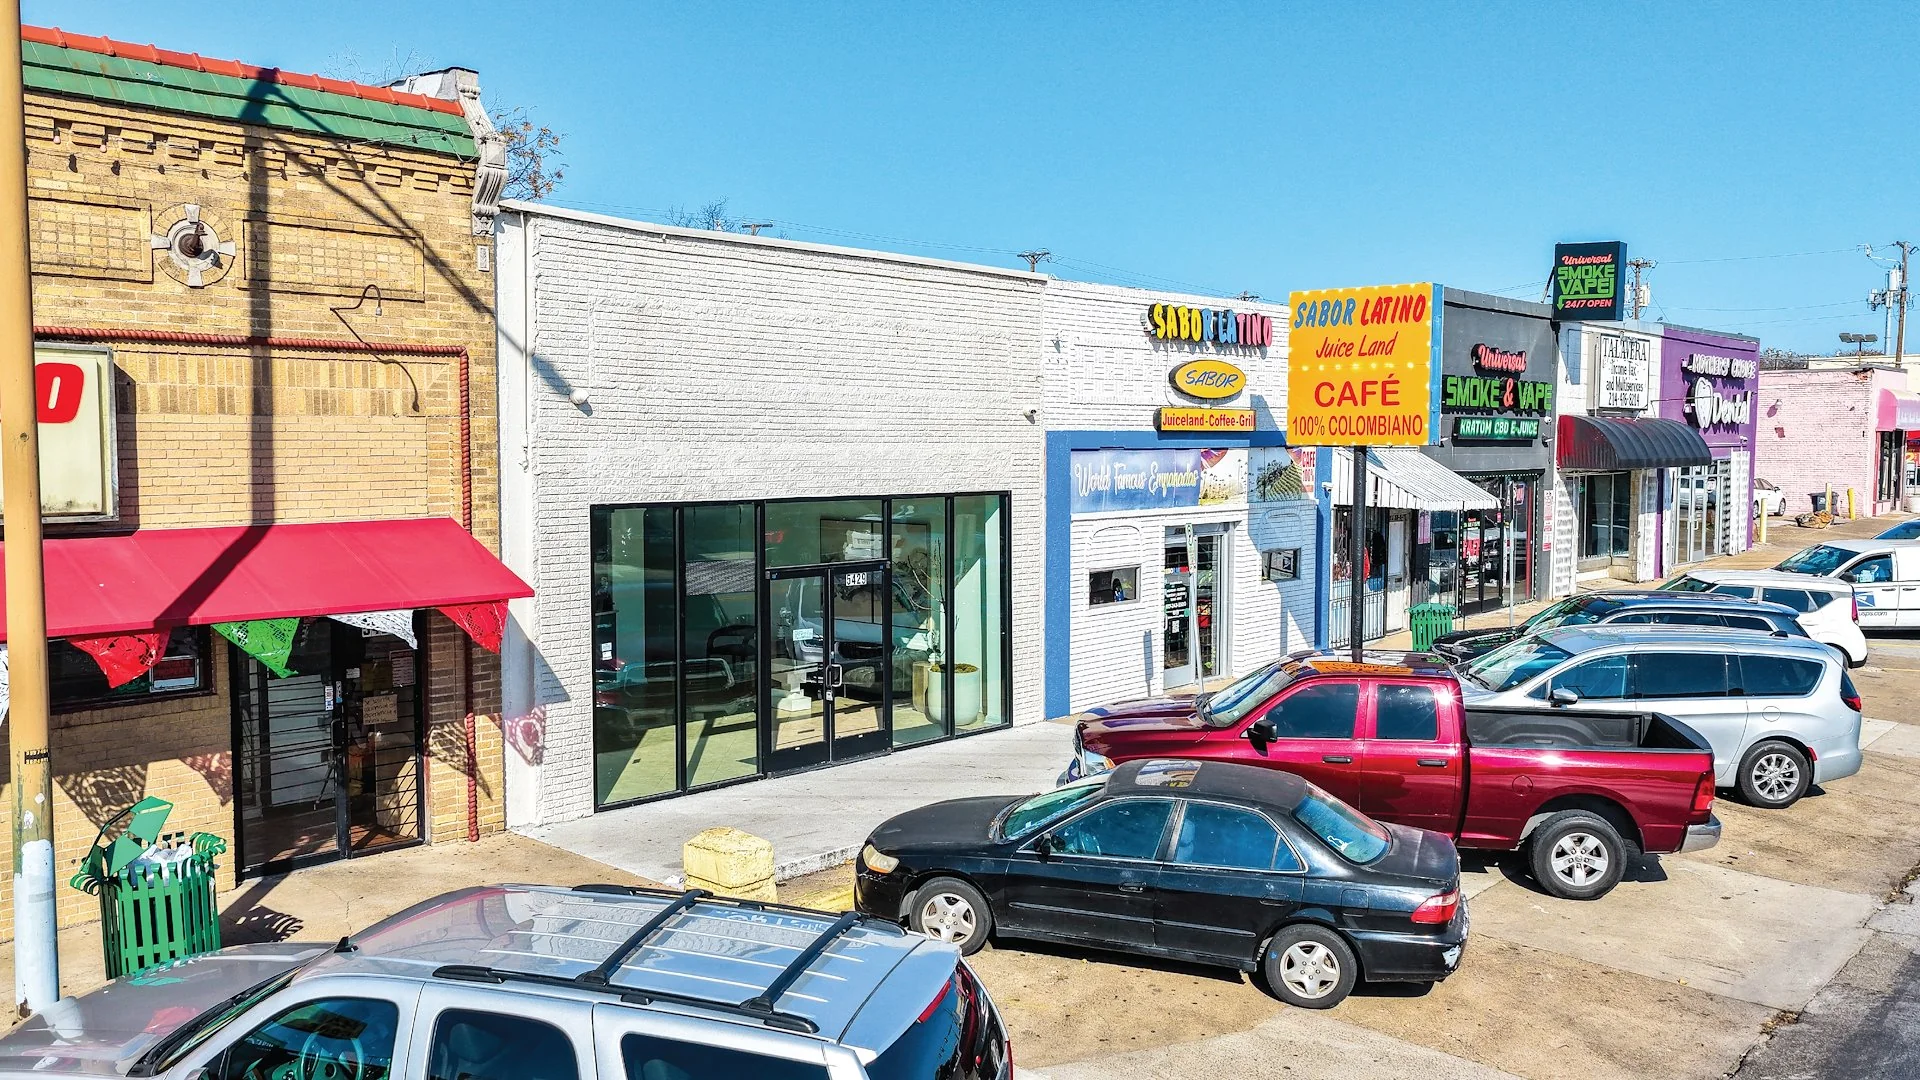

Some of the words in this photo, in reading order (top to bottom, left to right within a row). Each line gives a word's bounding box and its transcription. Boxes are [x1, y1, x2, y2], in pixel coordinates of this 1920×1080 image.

[1562, 254, 1613, 265] Universal
[1557, 264, 1615, 280] SMOKE
[1294, 298, 1356, 328] SABOR
[1360, 294, 1426, 326] LATINO
[1564, 300, 1587, 308] 24/7
[1587, 299, 1612, 308] OPEN
[1151, 303, 1214, 342] SABOR
[1217, 308, 1272, 347] LATINO
[1316, 337, 1355, 358] Juice
[1358, 331, 1398, 356] Land
[1602, 337, 1647, 361] TALAVERA
[1478, 345, 1527, 372] Universal
[1610, 362, 1627, 375] Income
[1628, 360, 1637, 376] Tax
[1185, 369, 1239, 388] SABOR
[1314, 373, 1400, 407] CAFÉ
[1606, 376, 1615, 391] and
[1615, 376, 1644, 392] Multiservices
[1446, 376, 1500, 408] SMOKE
[1503, 377, 1514, 407] &
[1518, 381, 1552, 410] VAPE
[1712, 390, 1751, 424] Dental
[1293, 416, 1325, 436] 100%
[1328, 414, 1423, 436] COLOMBIANO
[1460, 418, 1493, 434] KRATOM
[1494, 420, 1509, 435] CBD
[1074, 462, 1111, 497] World
[1113, 461, 1147, 495] Famous
[1148, 461, 1199, 497] Empanadas
[846, 573, 866, 585] 5429
